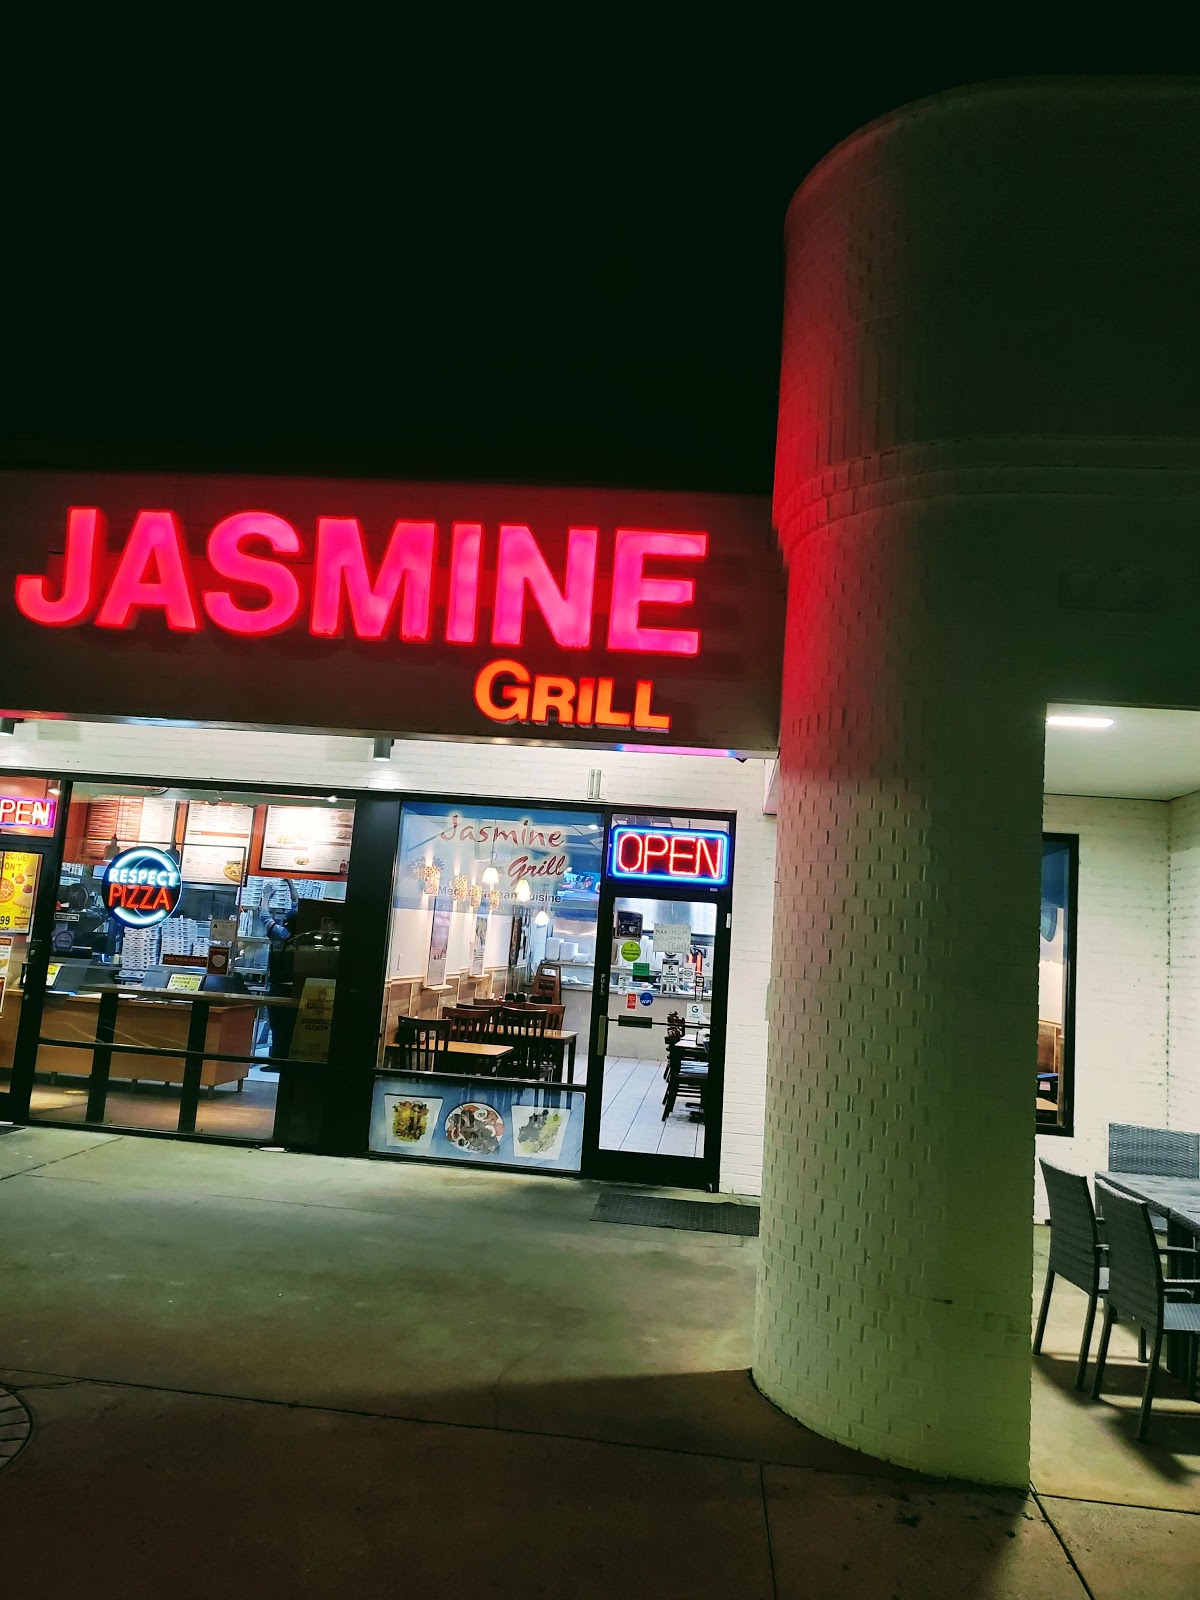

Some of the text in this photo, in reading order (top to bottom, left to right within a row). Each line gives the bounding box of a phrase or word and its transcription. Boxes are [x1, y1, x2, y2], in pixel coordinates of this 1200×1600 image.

[15, 505, 709, 656] JASMINE
[440, 814, 565, 847] Jasmine
[618, 832, 722, 878] OPEN
[108, 867, 177, 887] RESPECT
[507, 855, 568, 887] Grill
[108, 883, 170, 911] PIZZA
[528, 891, 562, 903] uisine
[691, 1005, 699, 1013] G
